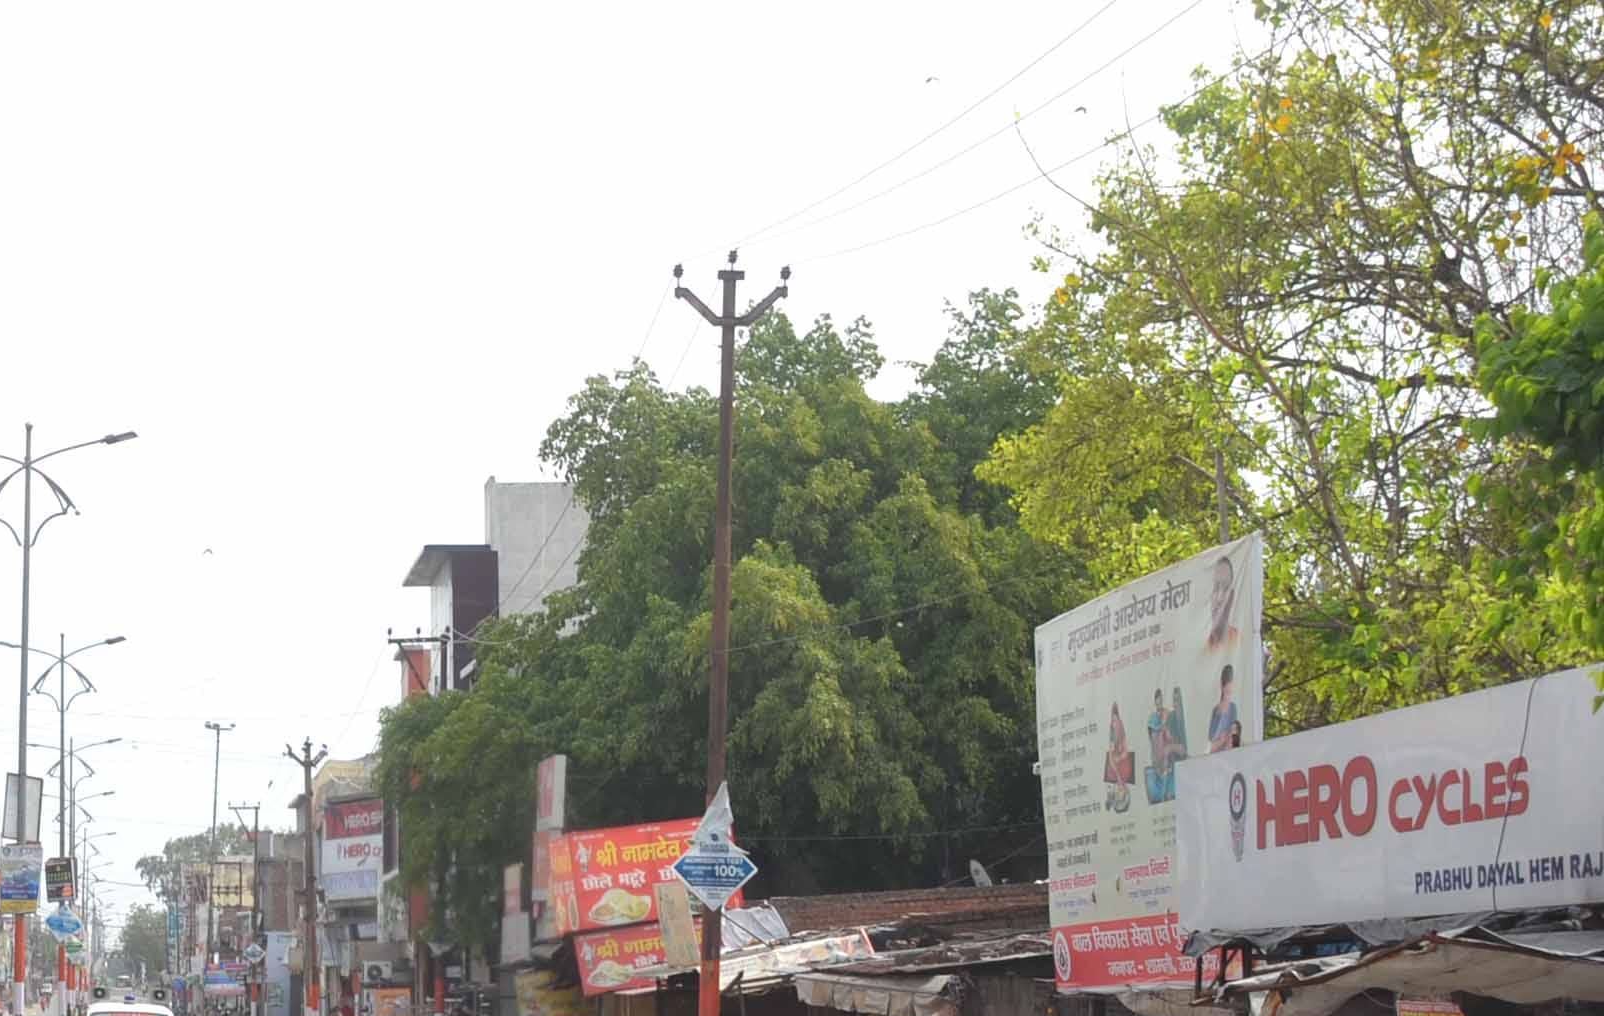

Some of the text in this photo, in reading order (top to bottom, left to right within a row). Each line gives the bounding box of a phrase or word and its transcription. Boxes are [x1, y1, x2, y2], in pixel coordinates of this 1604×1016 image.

[1159, 579, 1192, 612] मेला
[1256, 755, 1530, 850] HERO CYCLES
[622, 835, 682, 864] नामदेव
[714, 864, 746, 878] 100%
[1414, 865, 1473, 894] PRABHU
[1476, 859, 1525, 889] DAYAL
[1529, 855, 1564, 884] HEM
